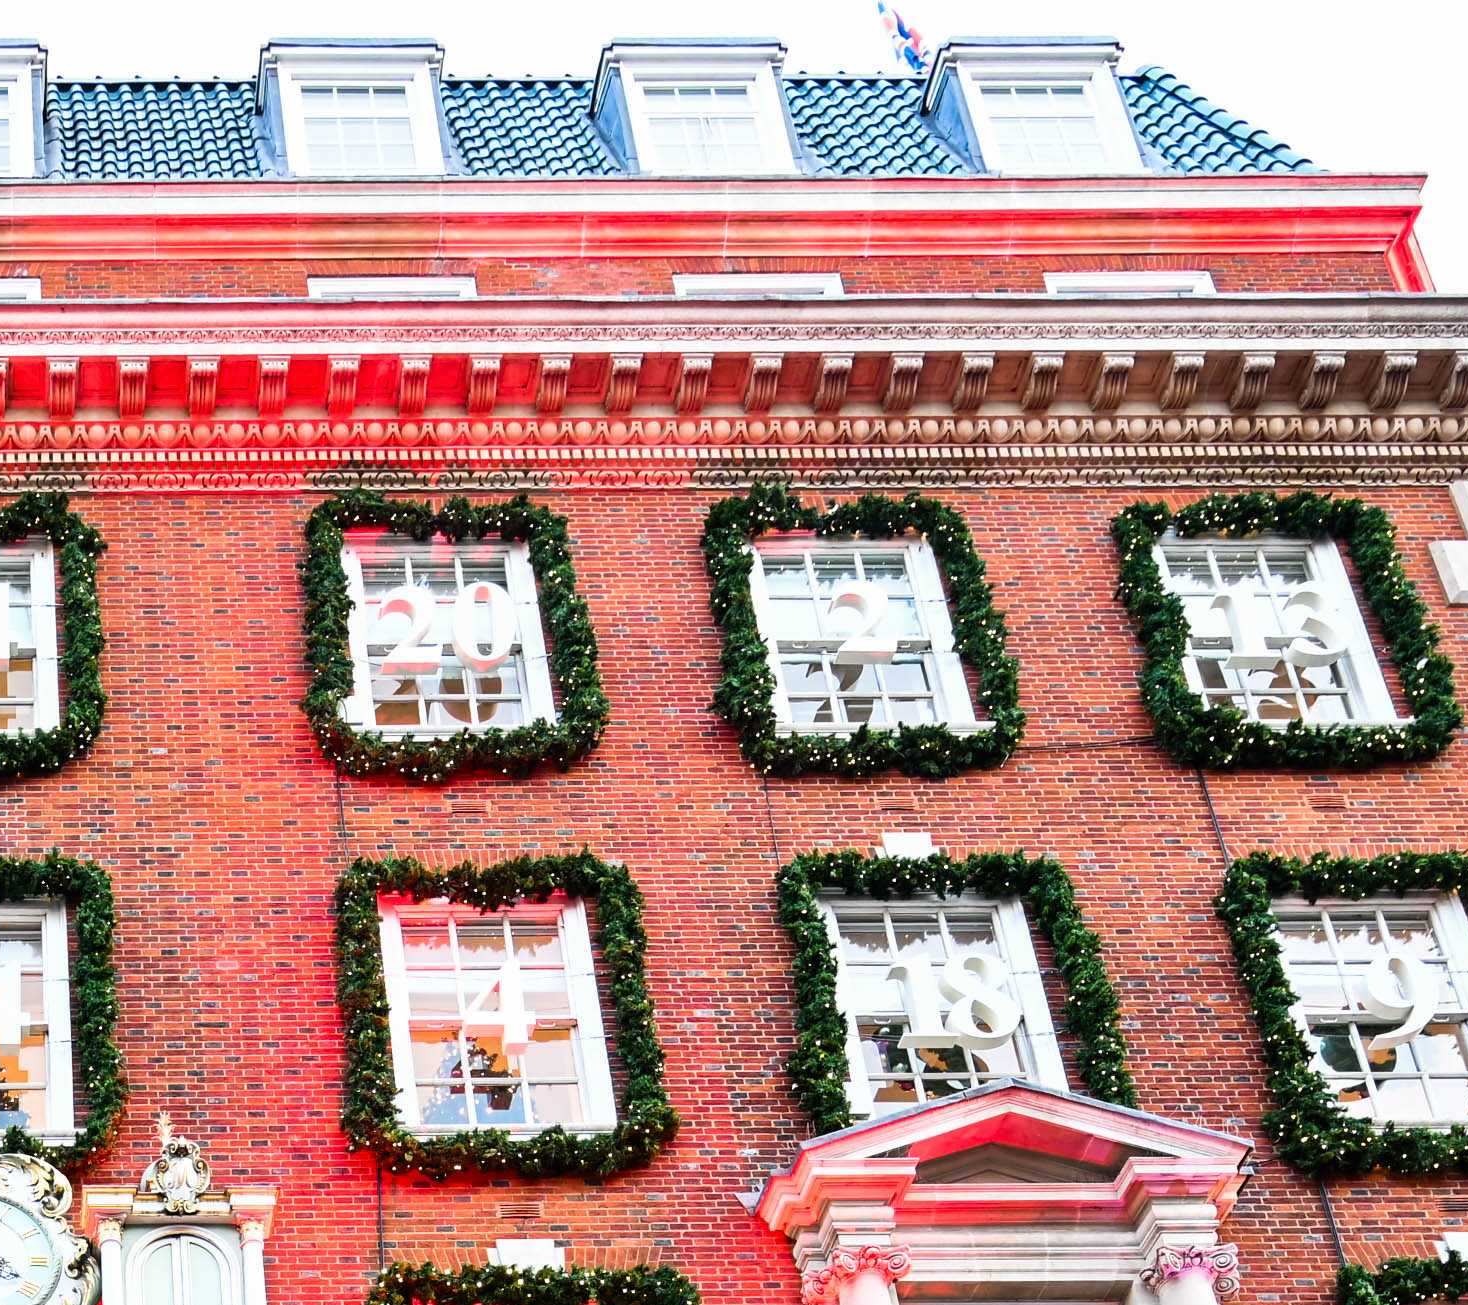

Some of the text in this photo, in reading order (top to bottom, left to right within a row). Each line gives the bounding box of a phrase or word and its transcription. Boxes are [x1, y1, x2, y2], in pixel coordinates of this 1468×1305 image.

[378, 581, 517, 675] 20
[827, 581, 898, 665] 2
[1210, 581, 1350, 669] 13
[467, 962, 536, 1055] 4
[887, 955, 1019, 1050] 18
[1365, 956, 1438, 1051] 9
